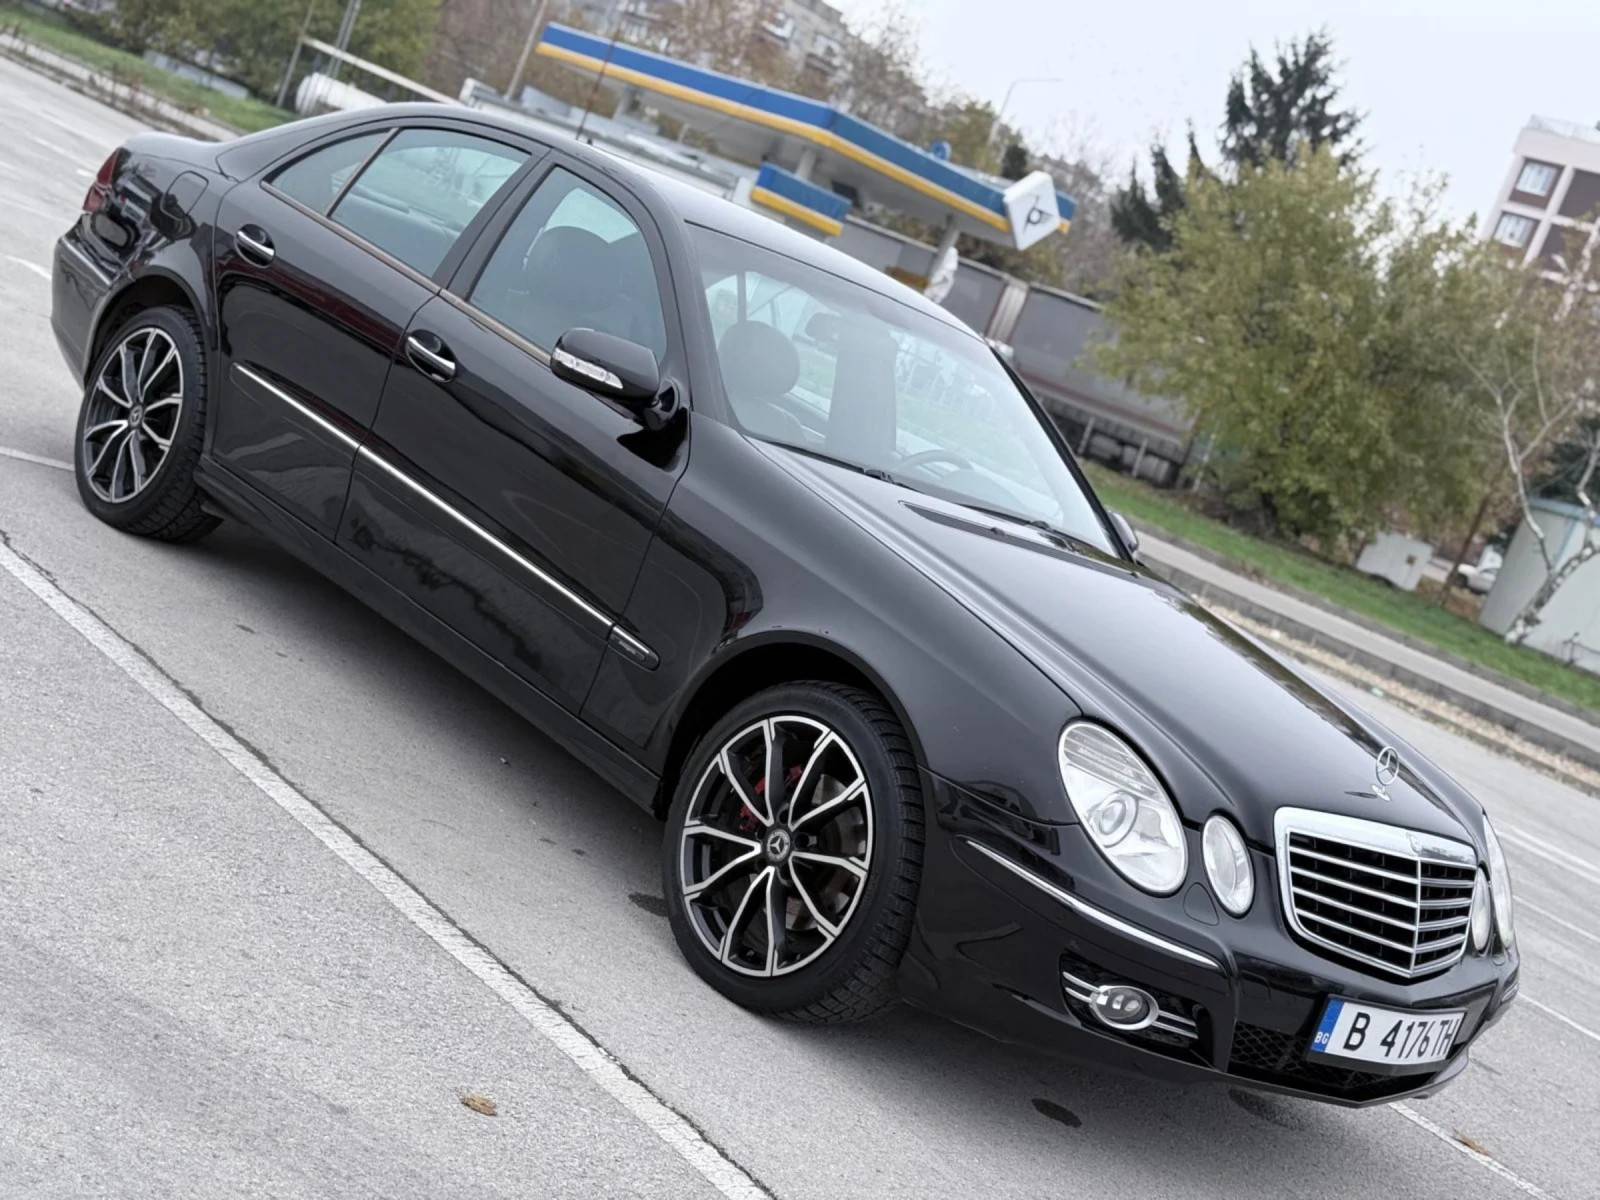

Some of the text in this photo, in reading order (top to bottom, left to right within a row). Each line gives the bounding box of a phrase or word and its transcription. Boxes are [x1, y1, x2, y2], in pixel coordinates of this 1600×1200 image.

[1314, 1031, 1330, 1043] BG
[1343, 1012, 1460, 1059] B 4176 TH
